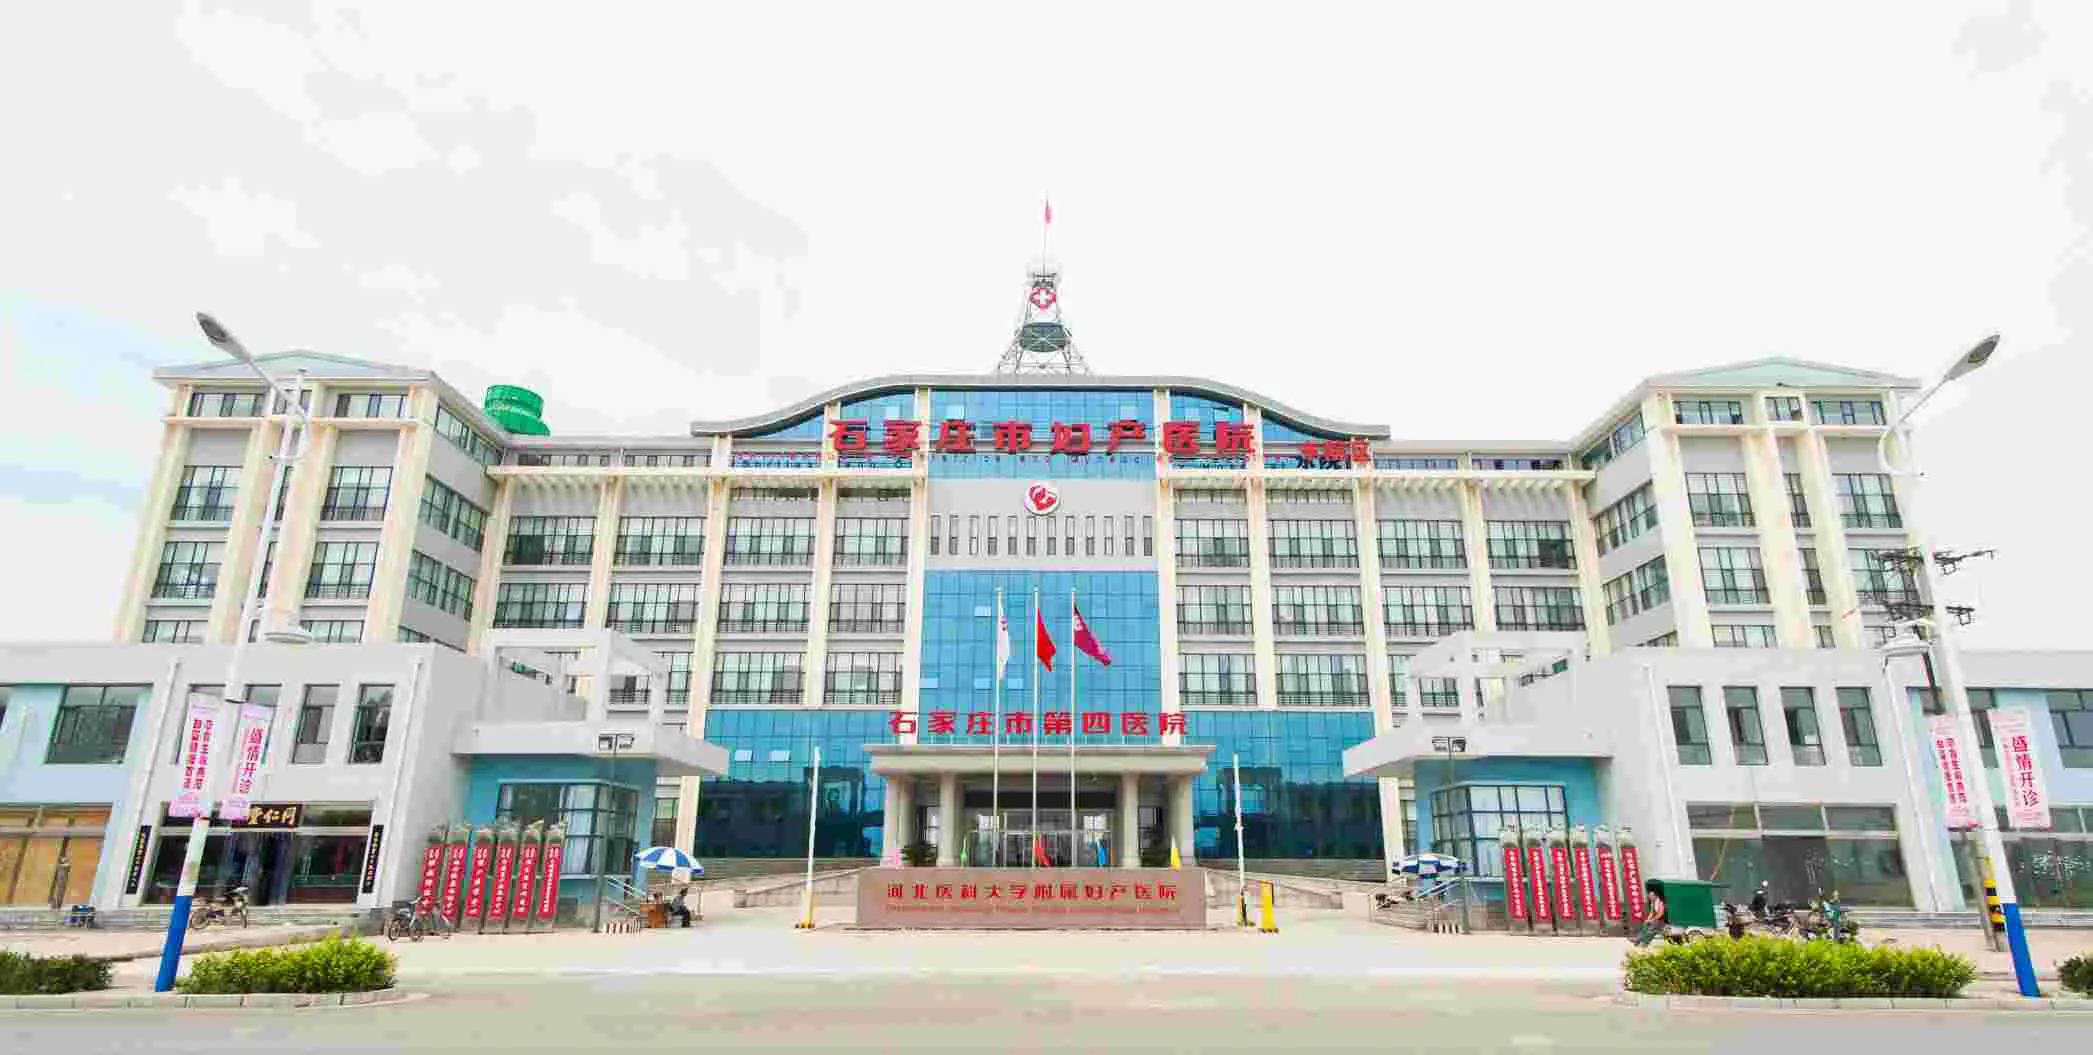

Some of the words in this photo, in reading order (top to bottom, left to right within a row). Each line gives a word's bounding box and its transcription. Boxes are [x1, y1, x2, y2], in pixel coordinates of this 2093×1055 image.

[828, 419, 1256, 454] 石家庄市妇产医院
[888, 711, 1188, 736] 石家庄市第四医院
